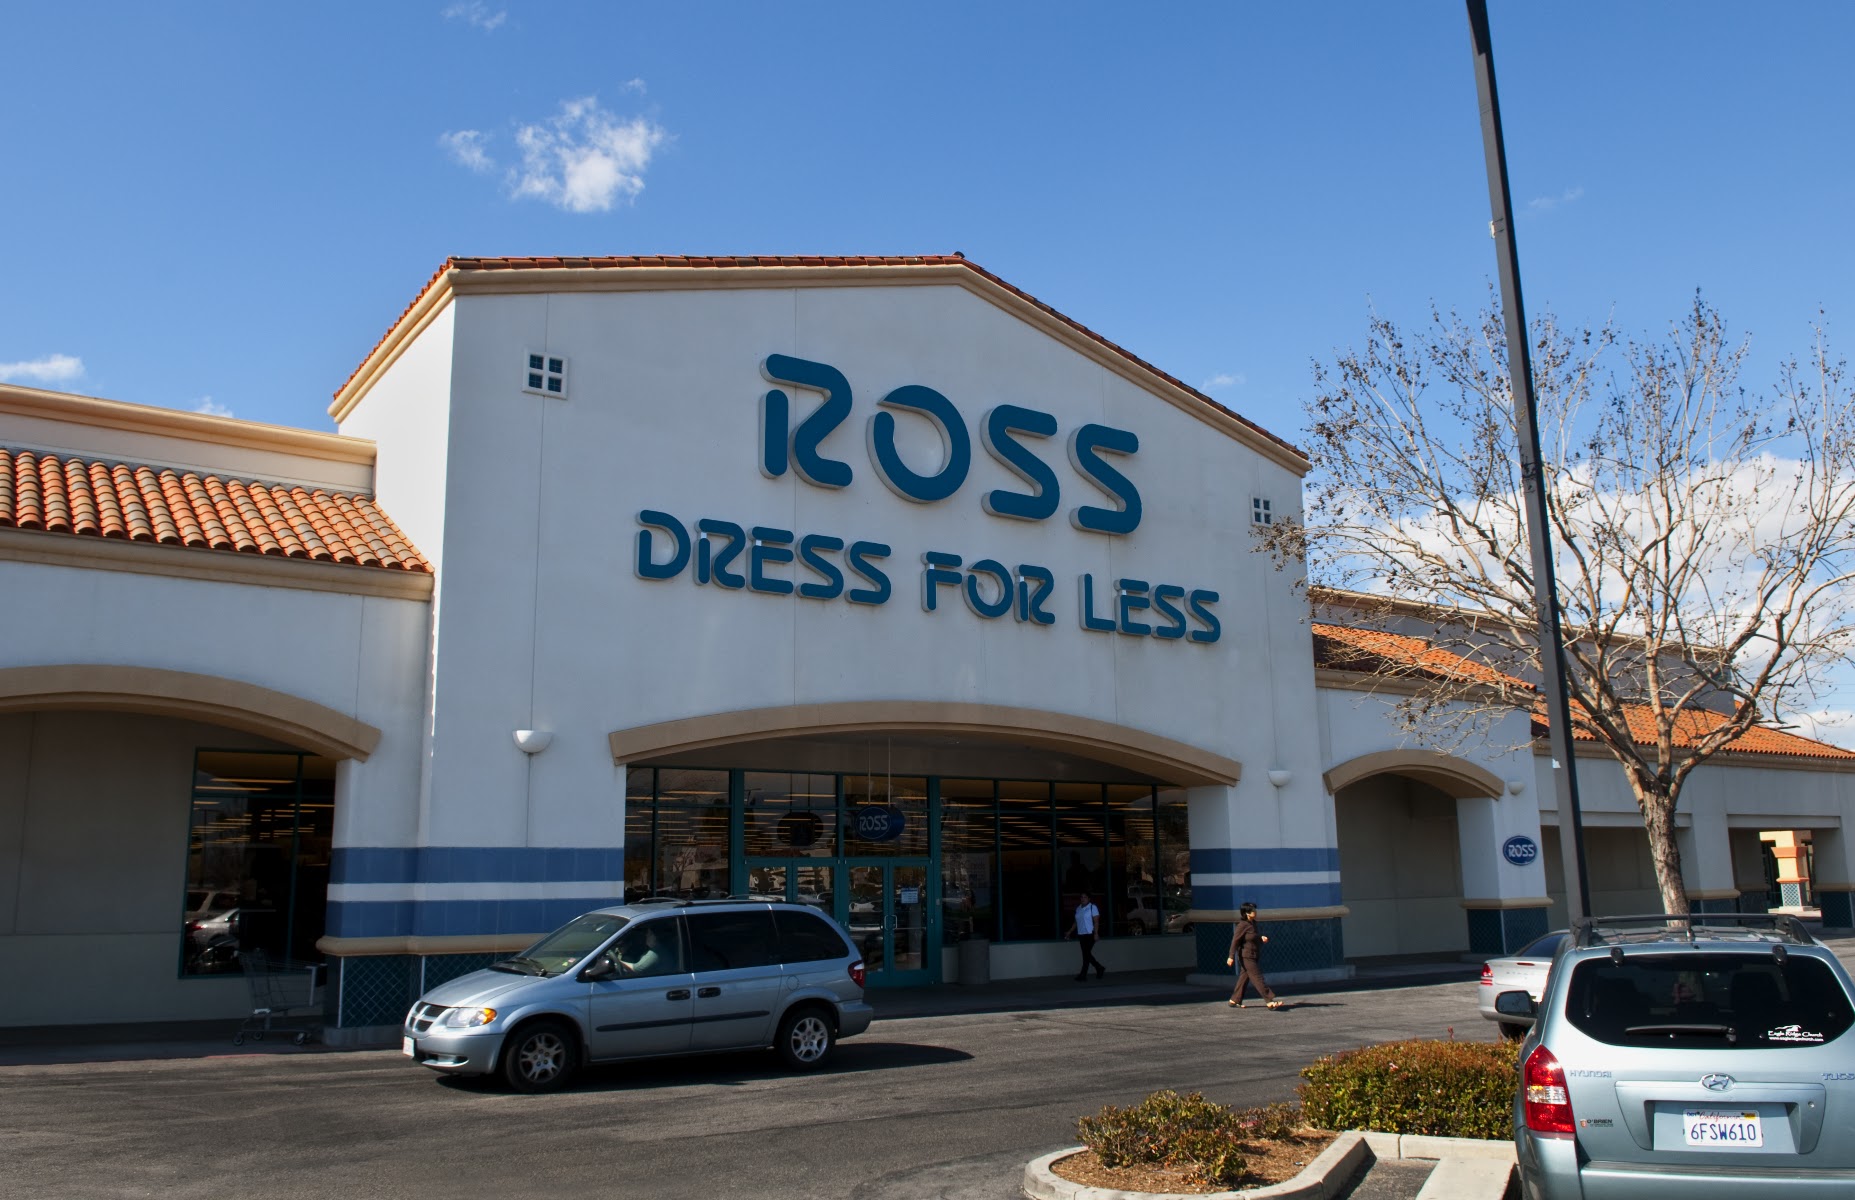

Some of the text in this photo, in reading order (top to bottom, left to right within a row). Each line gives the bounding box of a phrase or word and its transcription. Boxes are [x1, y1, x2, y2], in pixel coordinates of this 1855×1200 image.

[759, 353, 1143, 535] ROSS
[635, 509, 1222, 645] DRESS FOR LESS
[859, 814, 889, 832] ROSS
[1508, 844, 1535, 858] ROSS
[1570, 1069, 1612, 1078] HYUNDAI
[1699, 1111, 1742, 1122] California
[1690, 1123, 1757, 1141] 6FSW610
